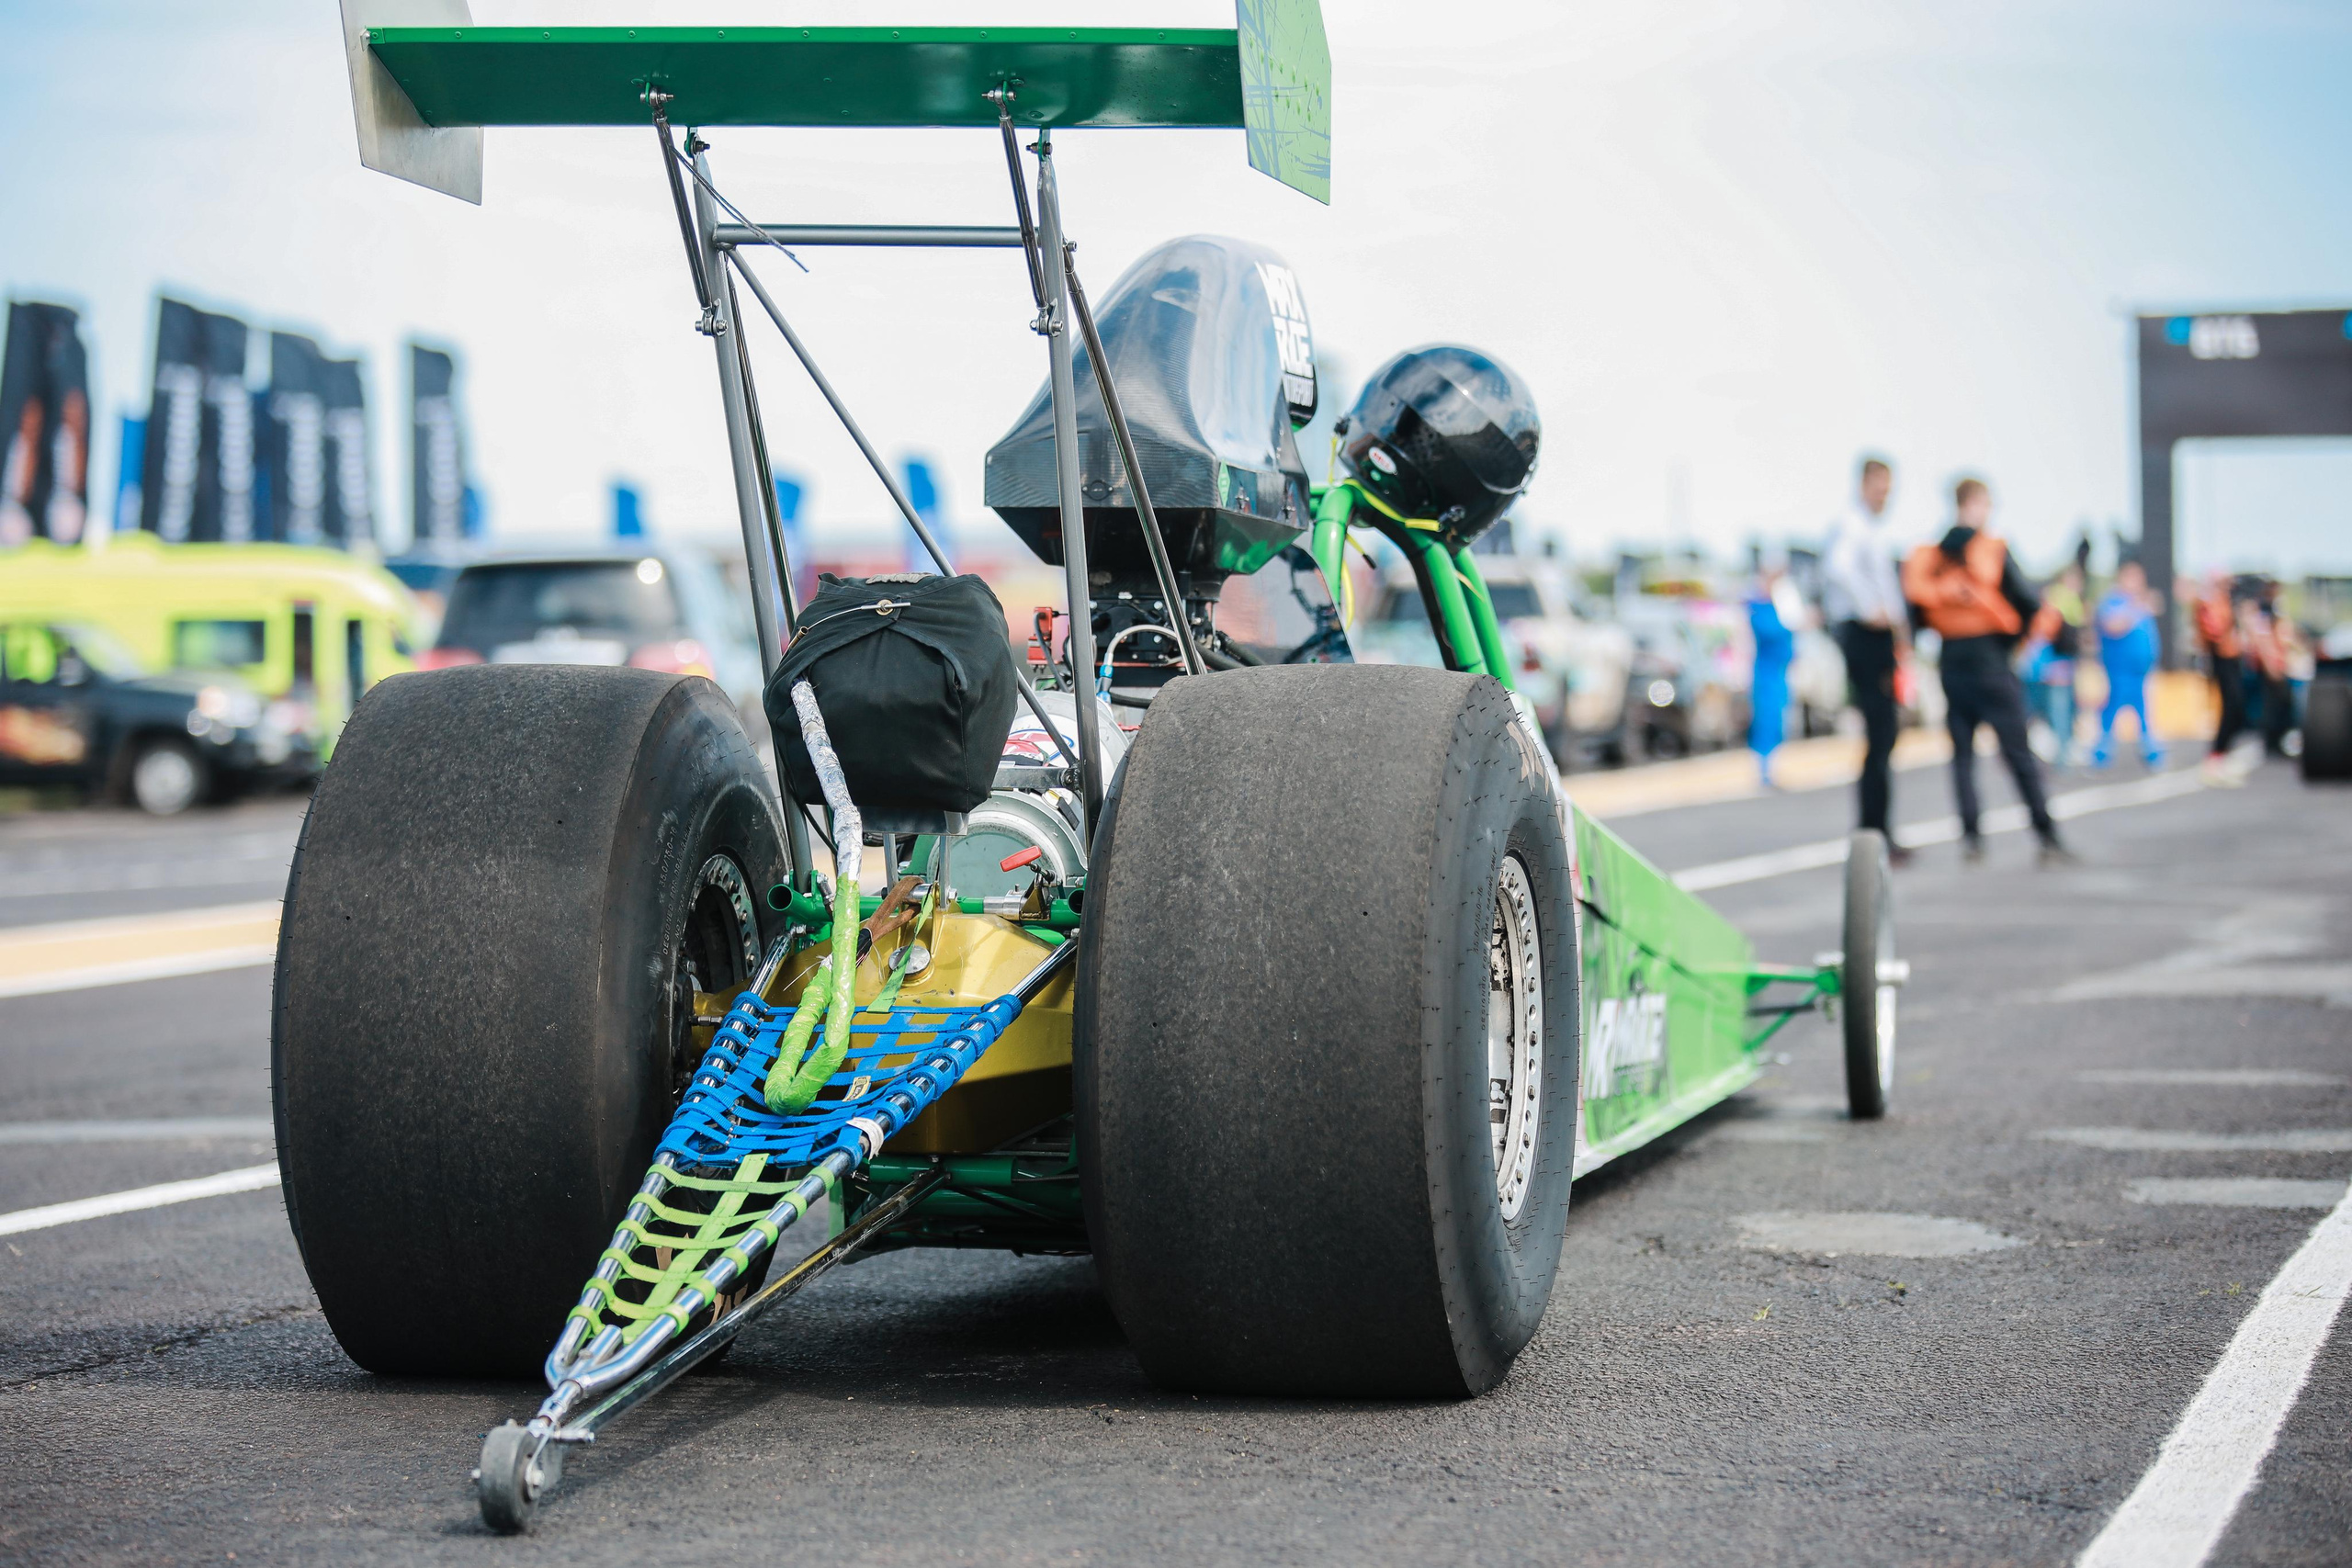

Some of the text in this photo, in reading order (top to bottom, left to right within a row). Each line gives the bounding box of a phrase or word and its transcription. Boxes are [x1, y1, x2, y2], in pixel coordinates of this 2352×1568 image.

[659, 826, 677, 889] 35.0/15.0-16
[673, 852, 684, 876] DRAG
[670, 879, 678, 900] FOR
[662, 903, 674, 955] DESIGNED
